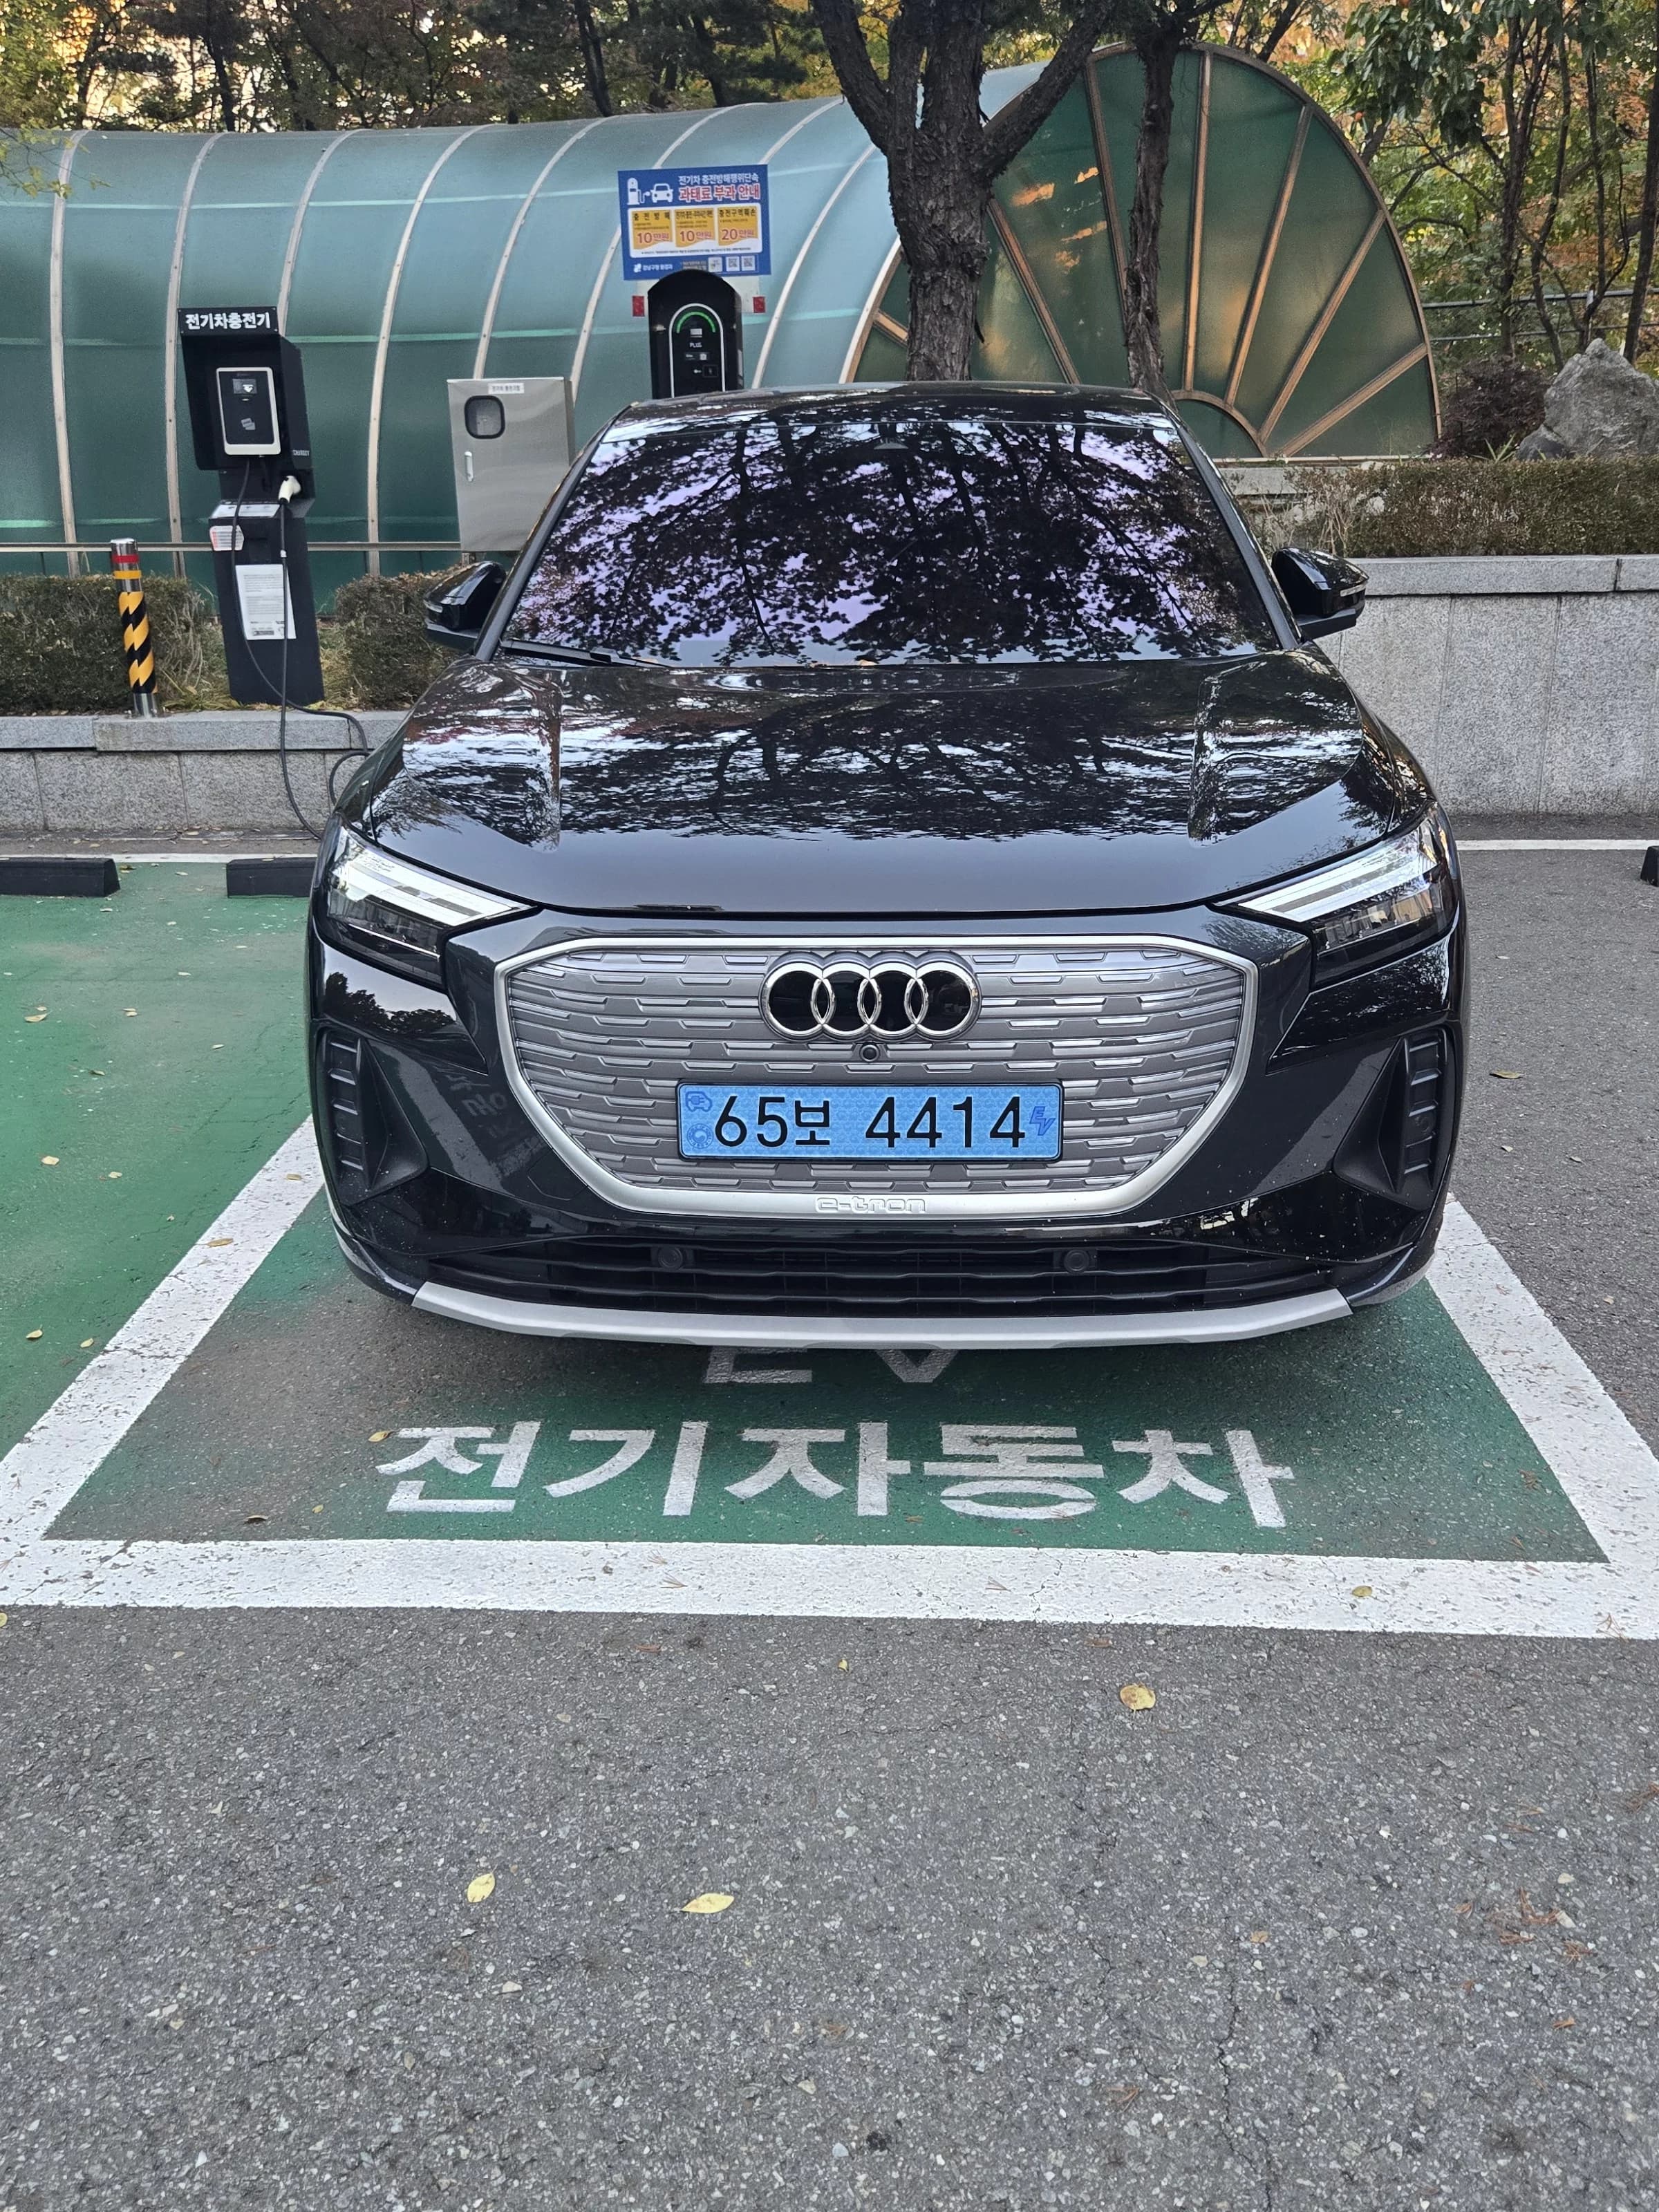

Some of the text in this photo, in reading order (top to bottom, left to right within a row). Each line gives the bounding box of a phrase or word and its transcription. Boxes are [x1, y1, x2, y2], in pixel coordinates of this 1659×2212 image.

[678, 176, 700, 185] 전기차
[679, 182, 760, 203] 과태료 부과 안내
[185, 312, 271, 330] 전기차충전기
[715, 1096, 830, 1147] 65보
[865, 1096, 1026, 1148] 4414
[1029, 1106, 1056, 1136] EV
[816, 1195, 926, 1214] e-tron
[375, 1421, 1294, 1528] 전기자동차
